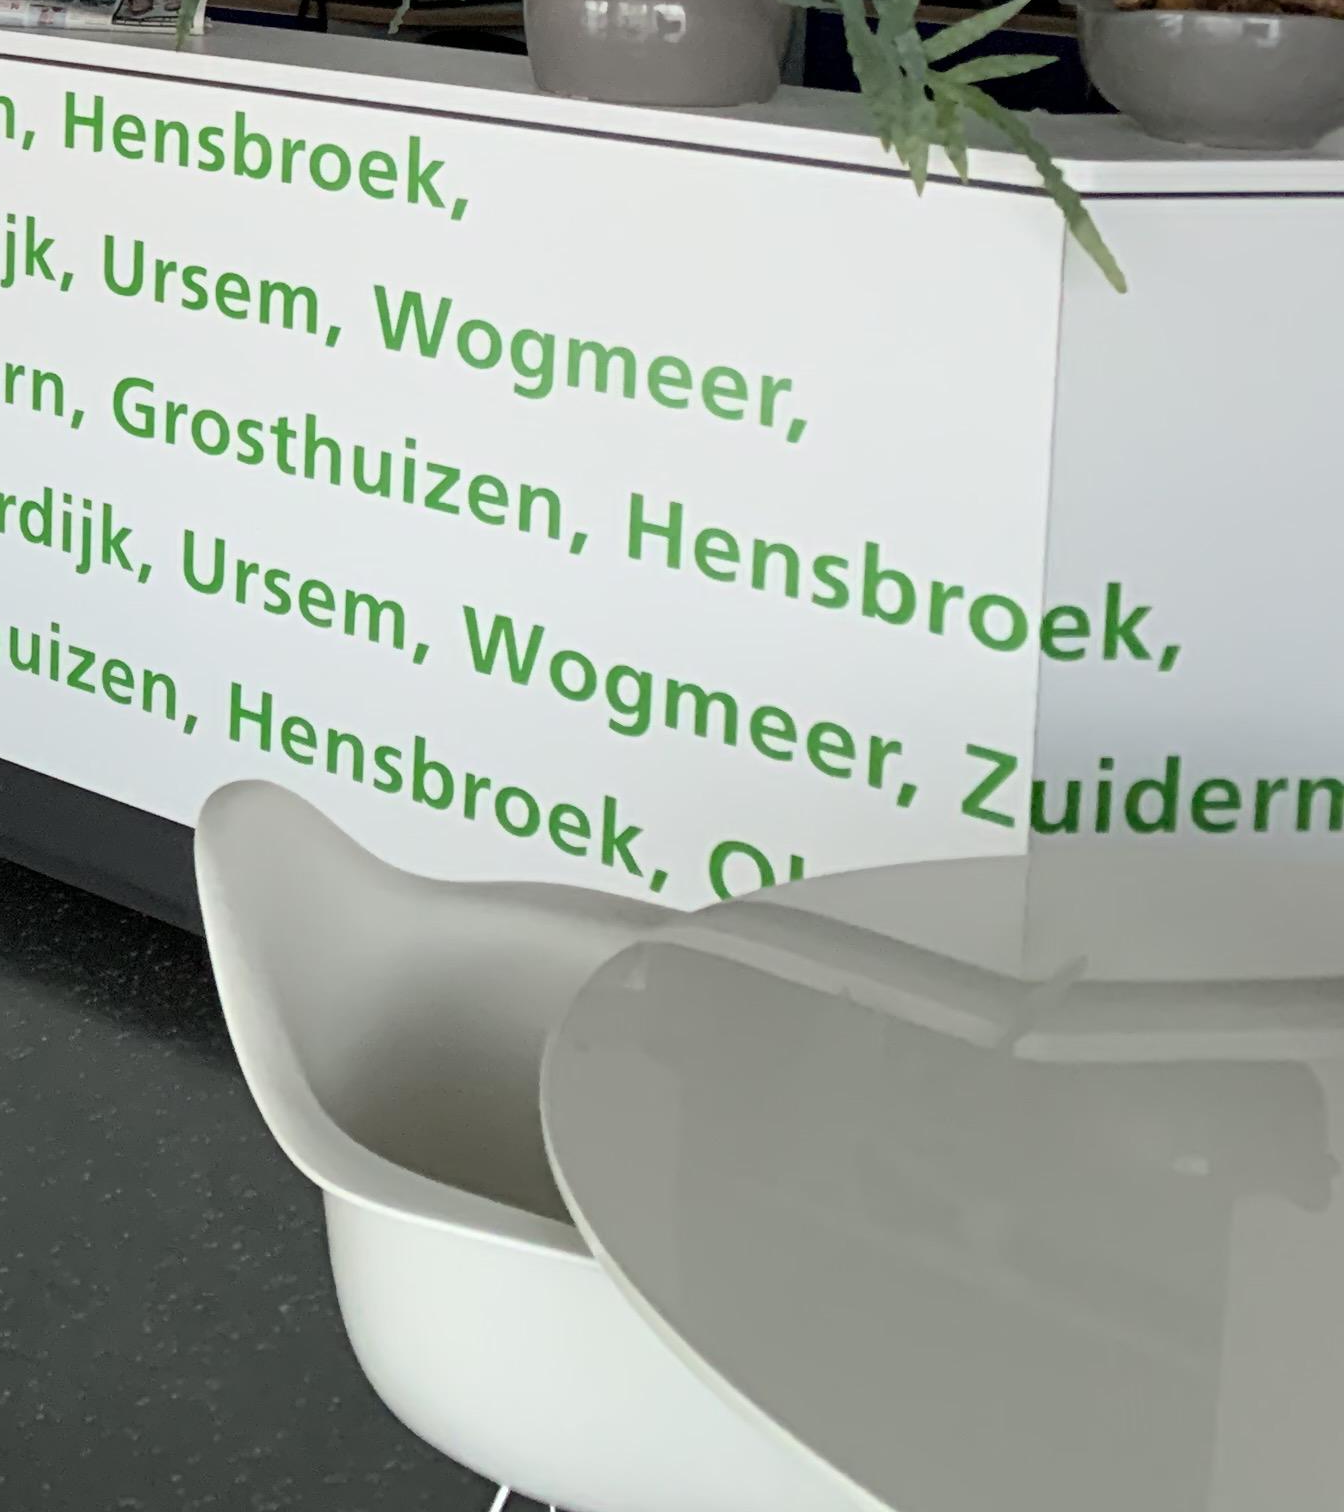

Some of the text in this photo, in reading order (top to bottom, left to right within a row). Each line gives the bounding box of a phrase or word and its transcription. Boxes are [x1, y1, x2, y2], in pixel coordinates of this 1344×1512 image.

[65, 92, 467, 220] Hensbroek,
[105, 235, 341, 347] Ursem,
[374, 285, 805, 442] Wogmeer,
[114, 378, 587, 554] Grosthuizen,
[629, 493, 1180, 671] Hensbroek,
[184, 530, 429, 664] Ursem,
[463, 606, 917, 807] Wogmeer,
[230, 682, 668, 892] Hensbroek,
